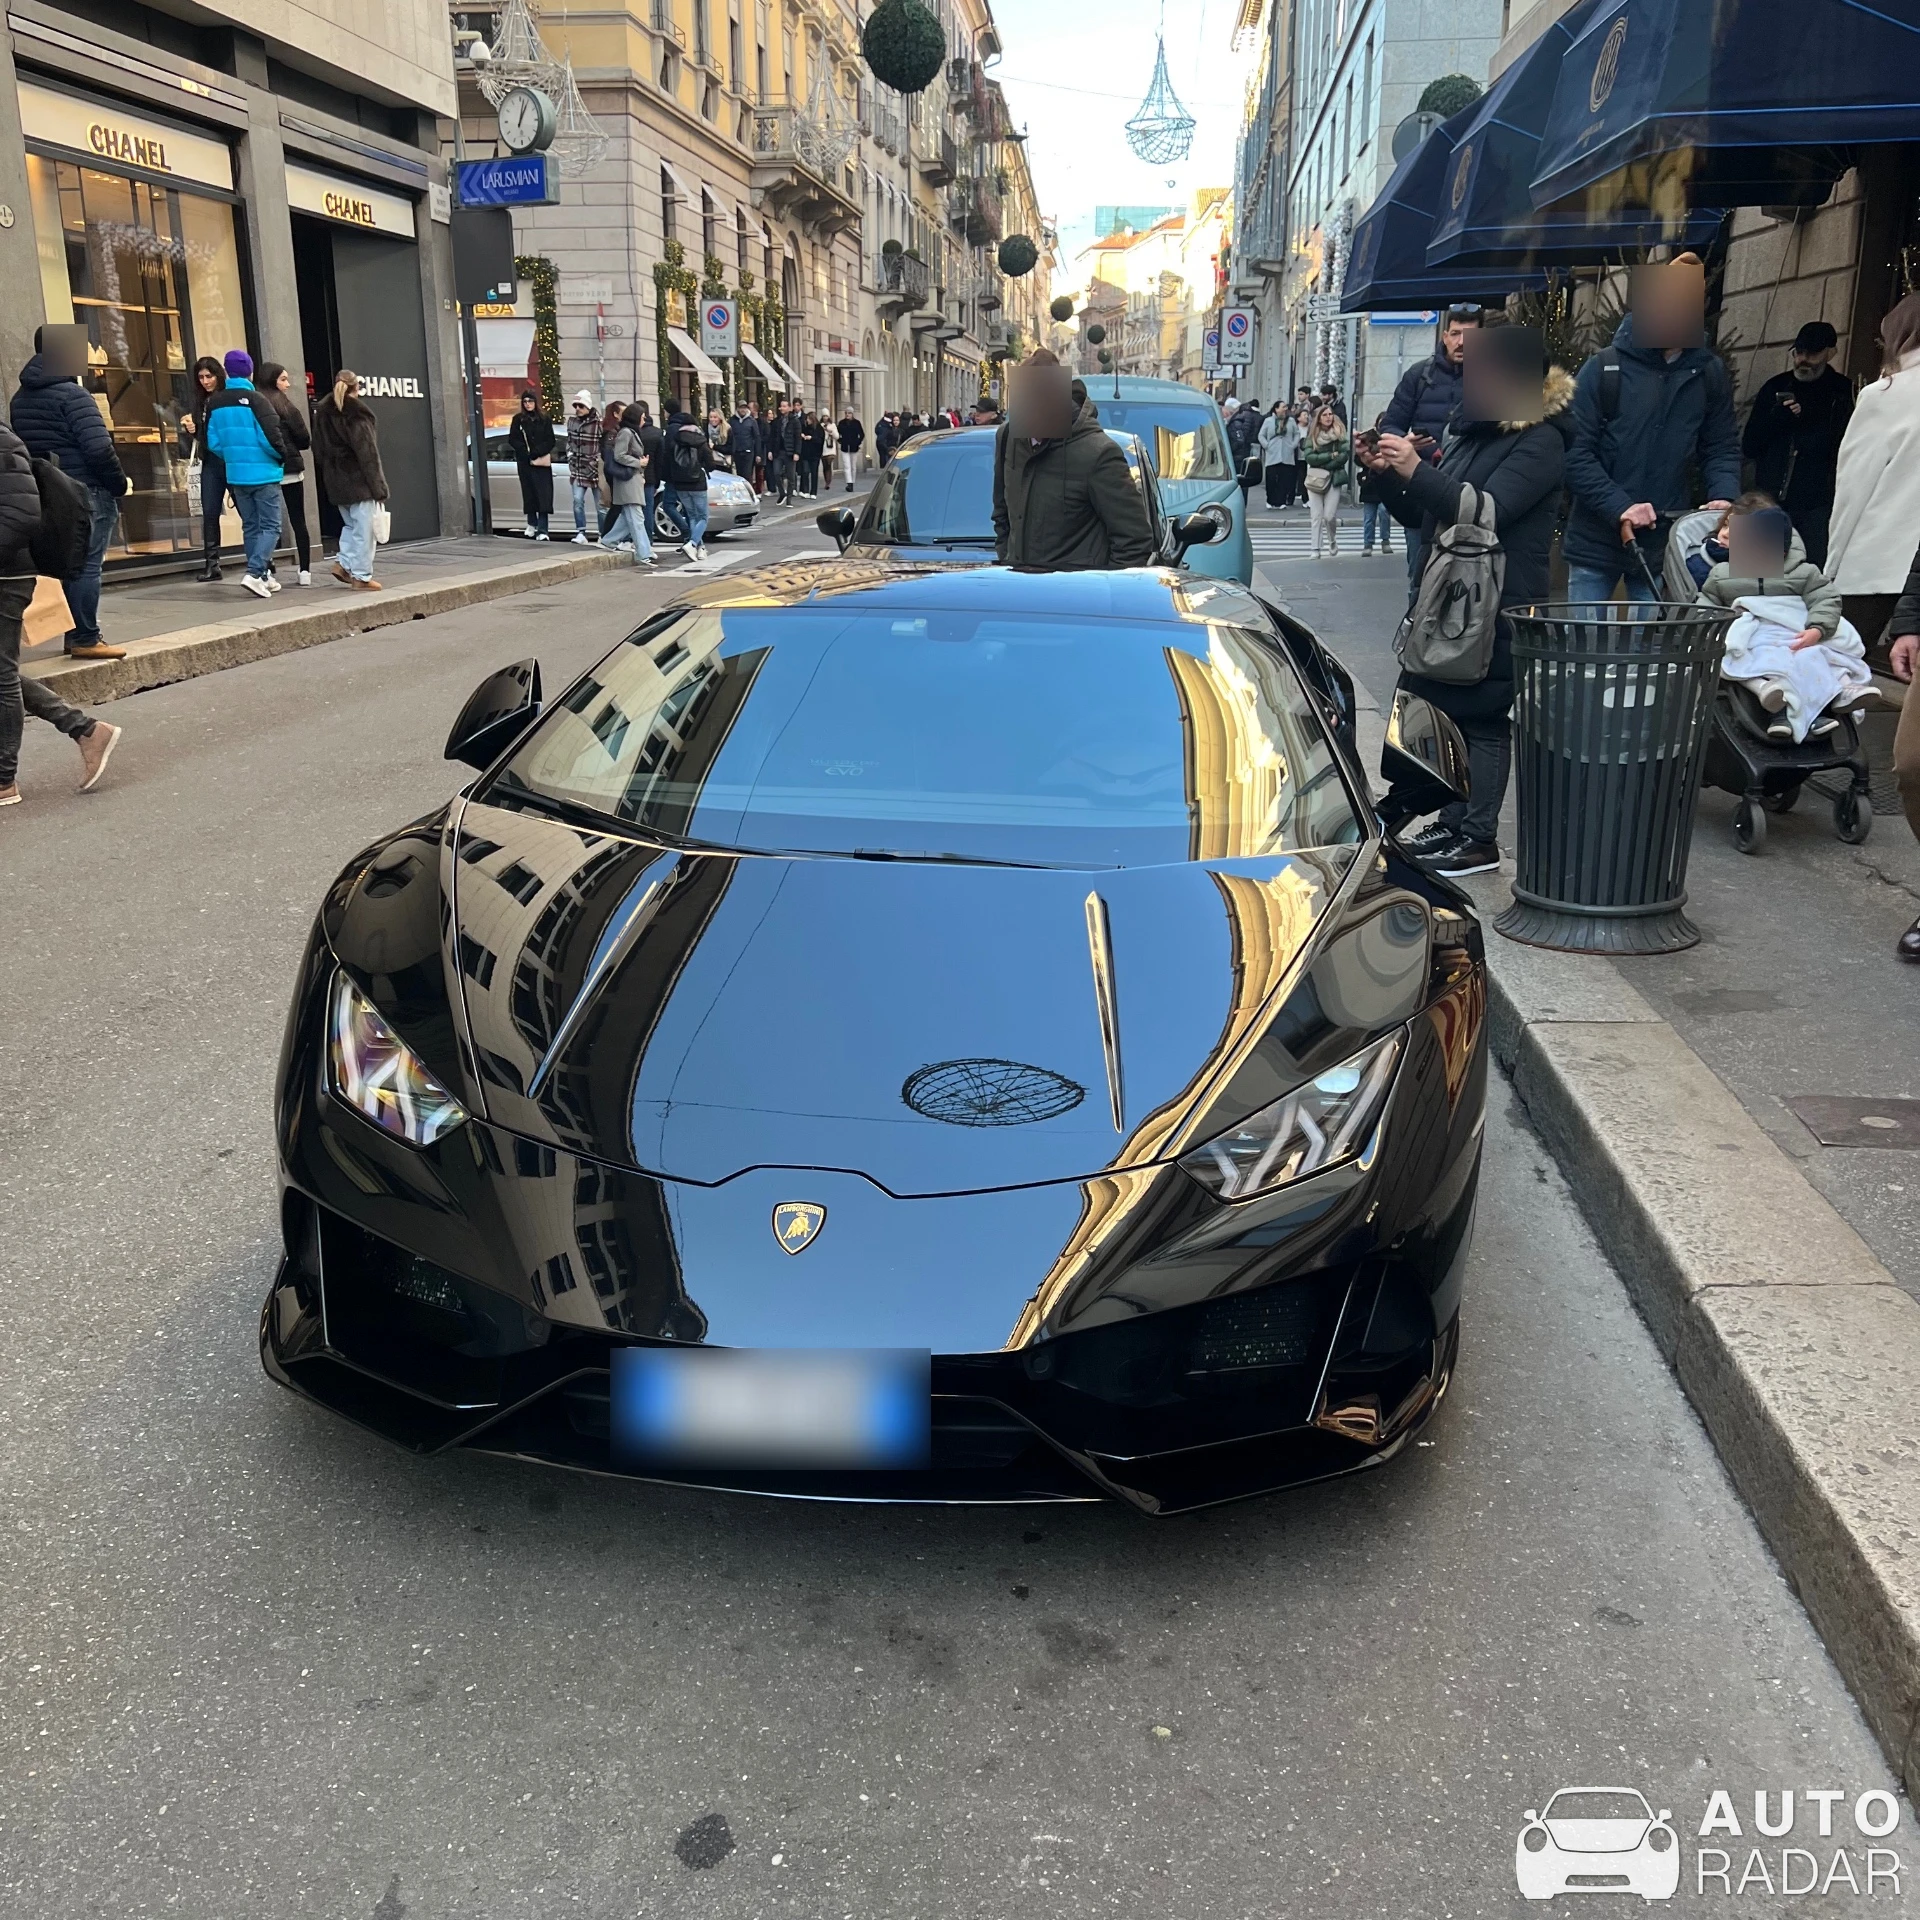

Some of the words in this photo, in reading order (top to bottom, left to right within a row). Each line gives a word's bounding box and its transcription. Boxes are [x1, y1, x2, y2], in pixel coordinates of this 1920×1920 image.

[88, 123, 171, 171] CHANEL
[482, 168, 539, 189] LARUSMIANI
[324, 192, 376, 225] CHANEL
[356, 376, 424, 398] CHANEL
[779, 1206, 821, 1215] LAMBORGHINI
